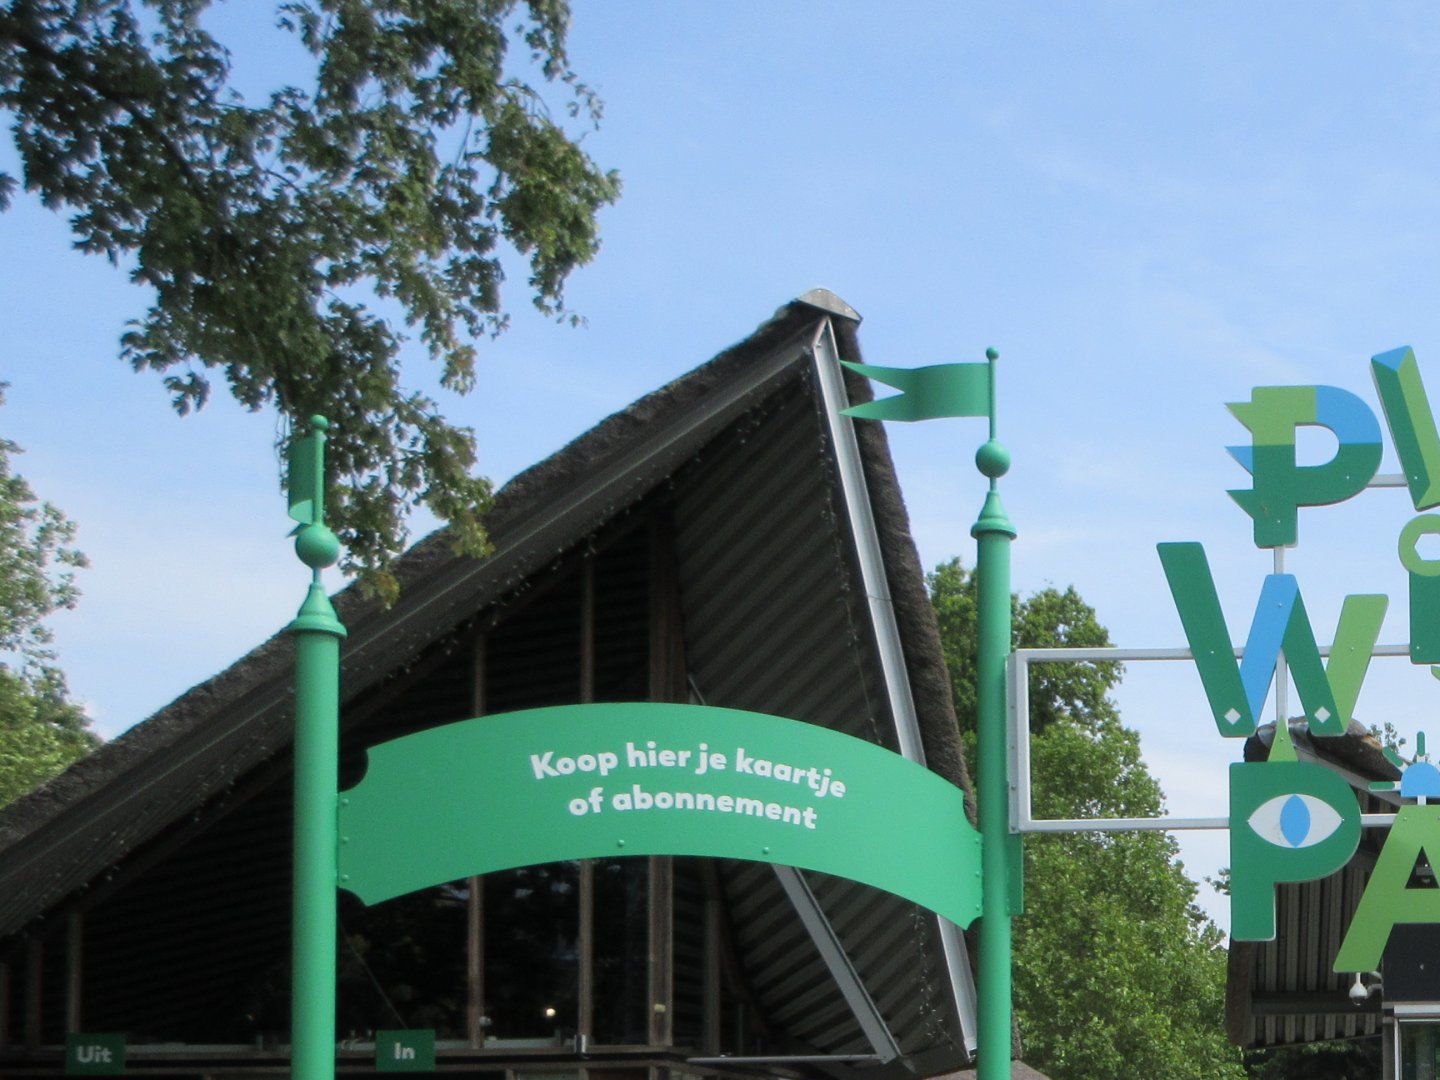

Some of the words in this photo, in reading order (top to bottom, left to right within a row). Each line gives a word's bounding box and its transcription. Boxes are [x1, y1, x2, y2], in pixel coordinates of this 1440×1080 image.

[530, 751, 618, 780] Koop
[626, 740, 691, 768] hier
[695, 743, 727, 775] je
[735, 748, 847, 798] kaartje
[568, 787, 604, 816] of
[611, 784, 818, 829] abonnement
[76, 1045, 113, 1063] Uit
[393, 1042, 416, 1060] In
